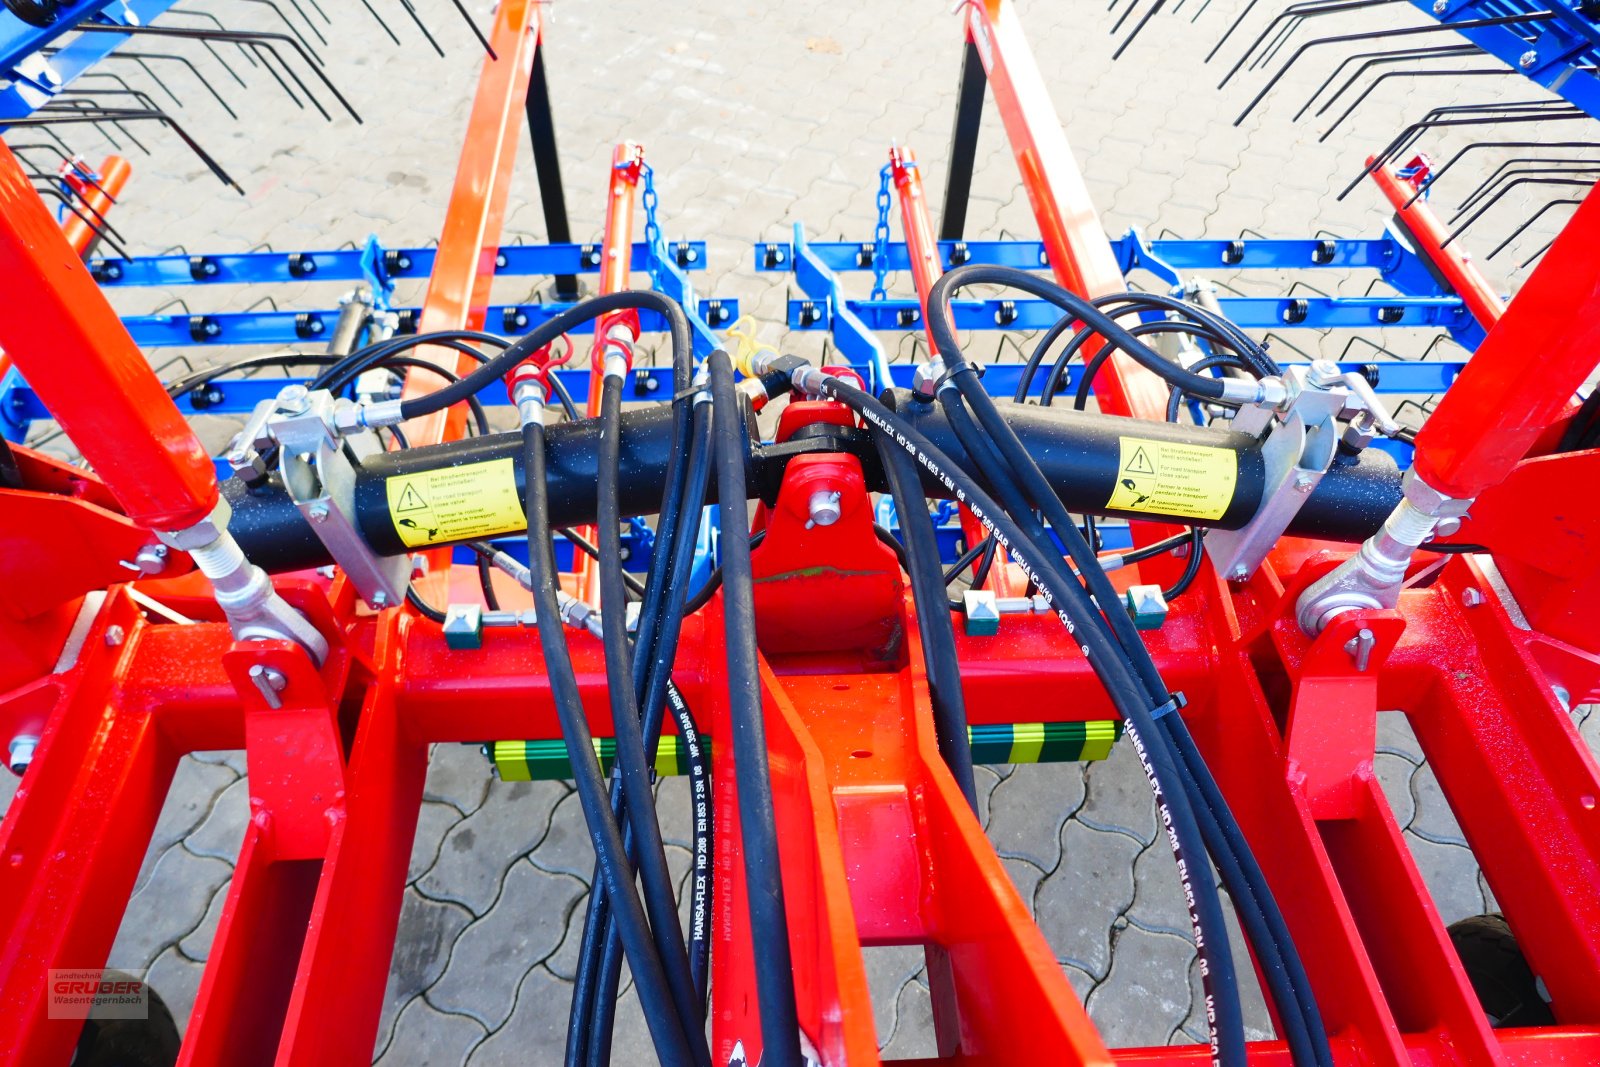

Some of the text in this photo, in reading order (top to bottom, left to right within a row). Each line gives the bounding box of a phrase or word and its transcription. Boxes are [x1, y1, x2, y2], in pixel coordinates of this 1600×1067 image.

[862, 405, 894, 438] HANSA-FLEX
[896, 434, 906, 447] HD
[906, 441, 916, 456] 208
[918, 452, 928, 466] EN
[940, 472, 945, 482] 2
[971, 502, 983, 518] WP
[982, 516, 994, 533] 350
[994, 530, 1009, 548] BAR
[1011, 548, 1030, 577] MSHA
[668, 688, 684, 710] MSHA
[680, 712, 692, 730] BAR
[686, 730, 696, 743] 350
[690, 744, 700, 758] WP
[694, 765, 702, 776] 08
[696, 779, 704, 792] SN
[1124, 718, 1162, 797] HANSA-FLEX
[1160, 804, 1172, 826] HD
[1167, 828, 1180, 852] 208
[1177, 859, 1188, 882] EN
[698, 802, 706, 817] 853
[698, 818, 706, 832] EN
[698, 837, 707, 854] 208
[698, 855, 706, 869] HD
[694, 875, 706, 940] HANSA-FLEX
